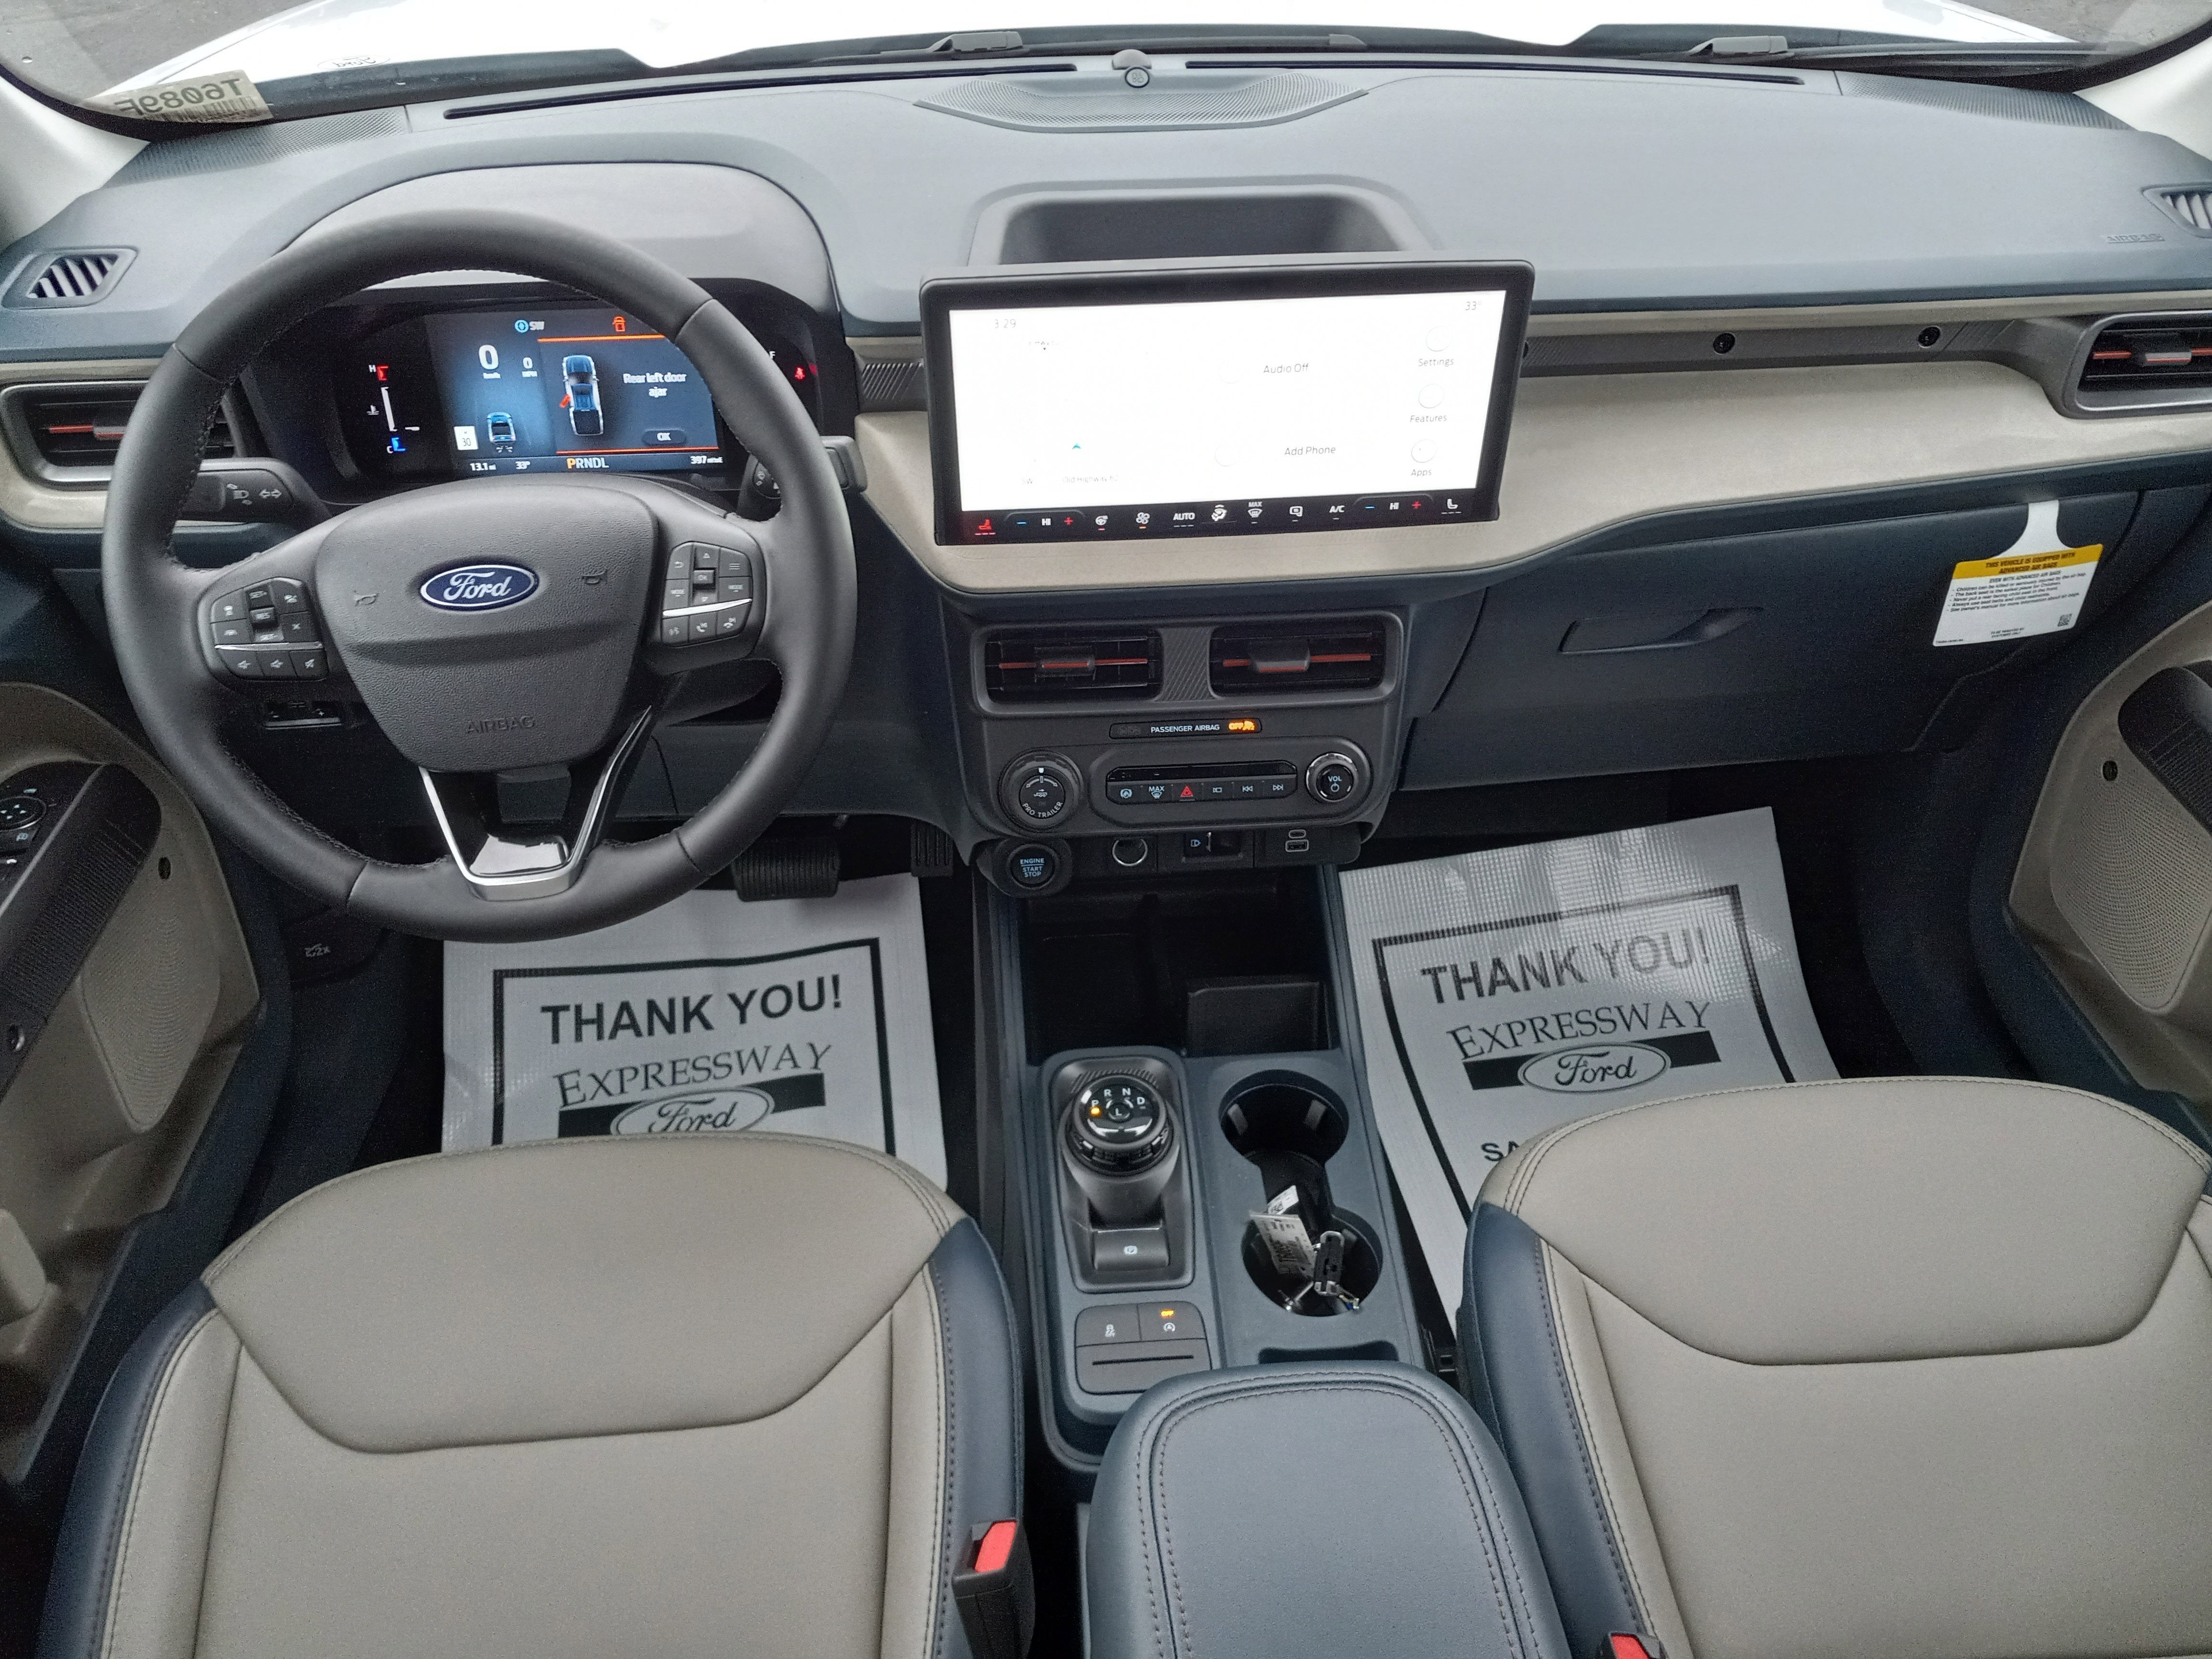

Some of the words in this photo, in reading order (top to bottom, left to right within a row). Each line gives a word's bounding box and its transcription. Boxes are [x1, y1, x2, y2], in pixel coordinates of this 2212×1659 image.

[479, 344, 499, 370] 0
[522, 357, 533, 369] 0
[1418, 358, 1455, 368] Settings
[368, 364, 376, 373] H
[1262, 363, 1292, 374] Audio
[1294, 363, 1309, 373] Off
[623, 373, 646, 384] Rear
[645, 372, 664, 383] left
[664, 372, 687, 383] door
[648, 386, 668, 398] ajar
[1409, 414, 1447, 423] Features
[461, 438, 471, 447] 30
[656, 432, 672, 441] OK
[1284, 446, 1303, 456] Add
[1305, 445, 1336, 455] Phone
[567, 457, 610, 469] PRNDL
[690, 455, 707, 465] 397
[469, 462, 489, 471] 13.1
[1410, 468, 1432, 477] Apps
[1329, 505, 1345, 513] A/C
[1173, 512, 1195, 521] AUTO
[443, 570, 513, 601] Ford
[467, 715, 537, 736] AIRBAG
[1150, 725, 1193, 733] PASSENGER
[1022, 803, 1035, 816] PRO
[1037, 801, 1063, 818] TRAILER
[1420, 943, 1590, 1006] THANK
[1593, 926, 1710, 980] YOU!
[540, 993, 715, 1045] THANK
[727, 974, 842, 1025] YOU!
[1446, 999, 1712, 1060] EXPRESSWAY
[1553, 1050, 1637, 1087] Ford
[552, 1041, 832, 1109] EXPRESSWAY
[1104, 1088, 1112, 1097] R
[1121, 1088, 1131, 1096] N
[1136, 1096, 1146, 1105] D
[648, 1097, 738, 1133] Ford
[1115, 1108, 1122, 1117] L
